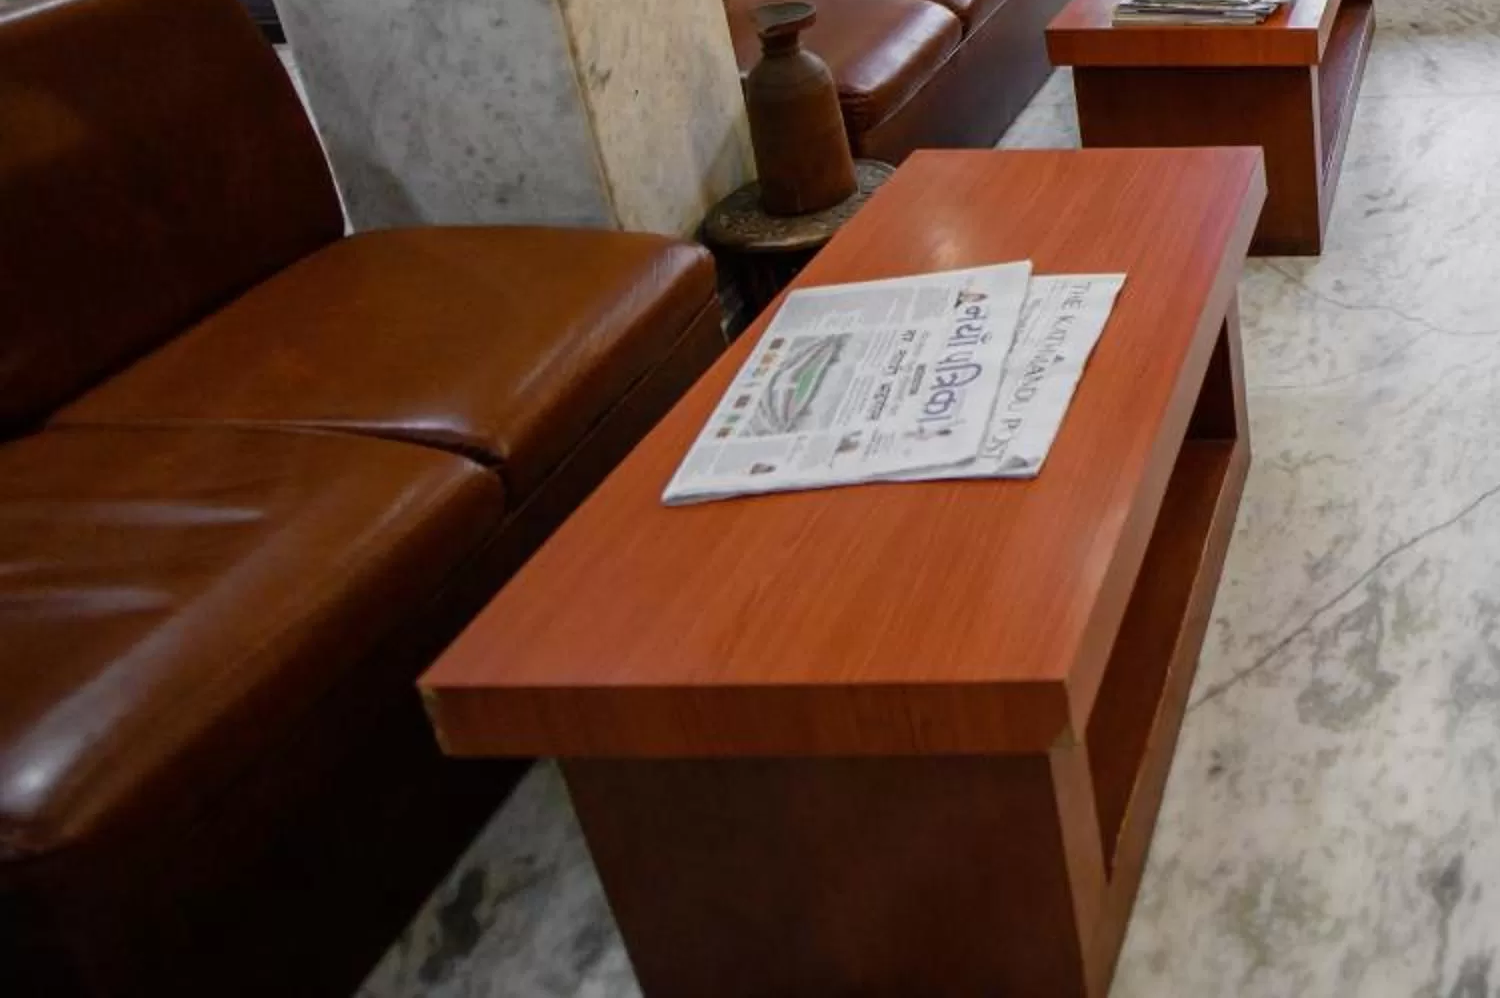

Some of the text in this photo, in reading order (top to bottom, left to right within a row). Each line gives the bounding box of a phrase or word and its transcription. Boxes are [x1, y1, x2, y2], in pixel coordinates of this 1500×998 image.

[1061, 281, 1092, 311] THE
[916, 304, 993, 425] नयाँ पत्रिका
